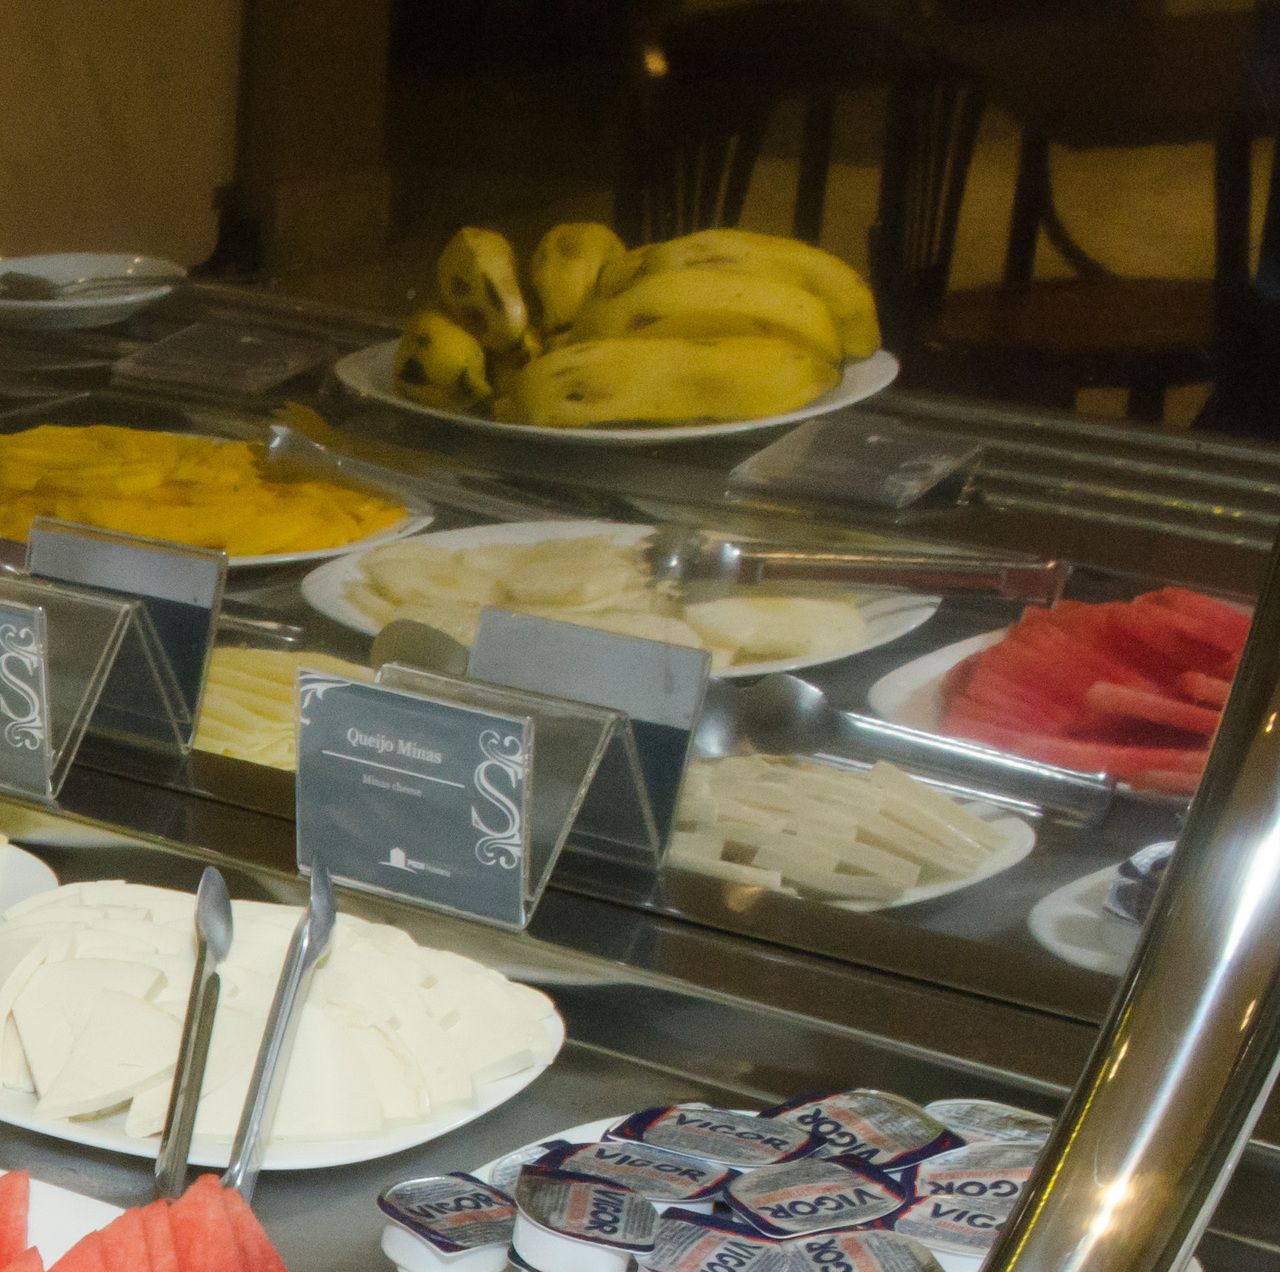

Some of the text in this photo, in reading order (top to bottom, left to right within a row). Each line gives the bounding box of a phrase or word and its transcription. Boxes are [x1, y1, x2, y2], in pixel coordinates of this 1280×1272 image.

[346, 727, 443, 764] Queijo Minas
[676, 1112, 790, 1152] VIGOR
[595, 1147, 707, 1183] VIGOR
[756, 1188, 886, 1220] VIGOR
[927, 1179, 1026, 1198] GOR
[404, 1192, 502, 1220] VIGOR
[583, 1189, 627, 1236] VIGOR
[930, 1202, 1009, 1232] VIG
